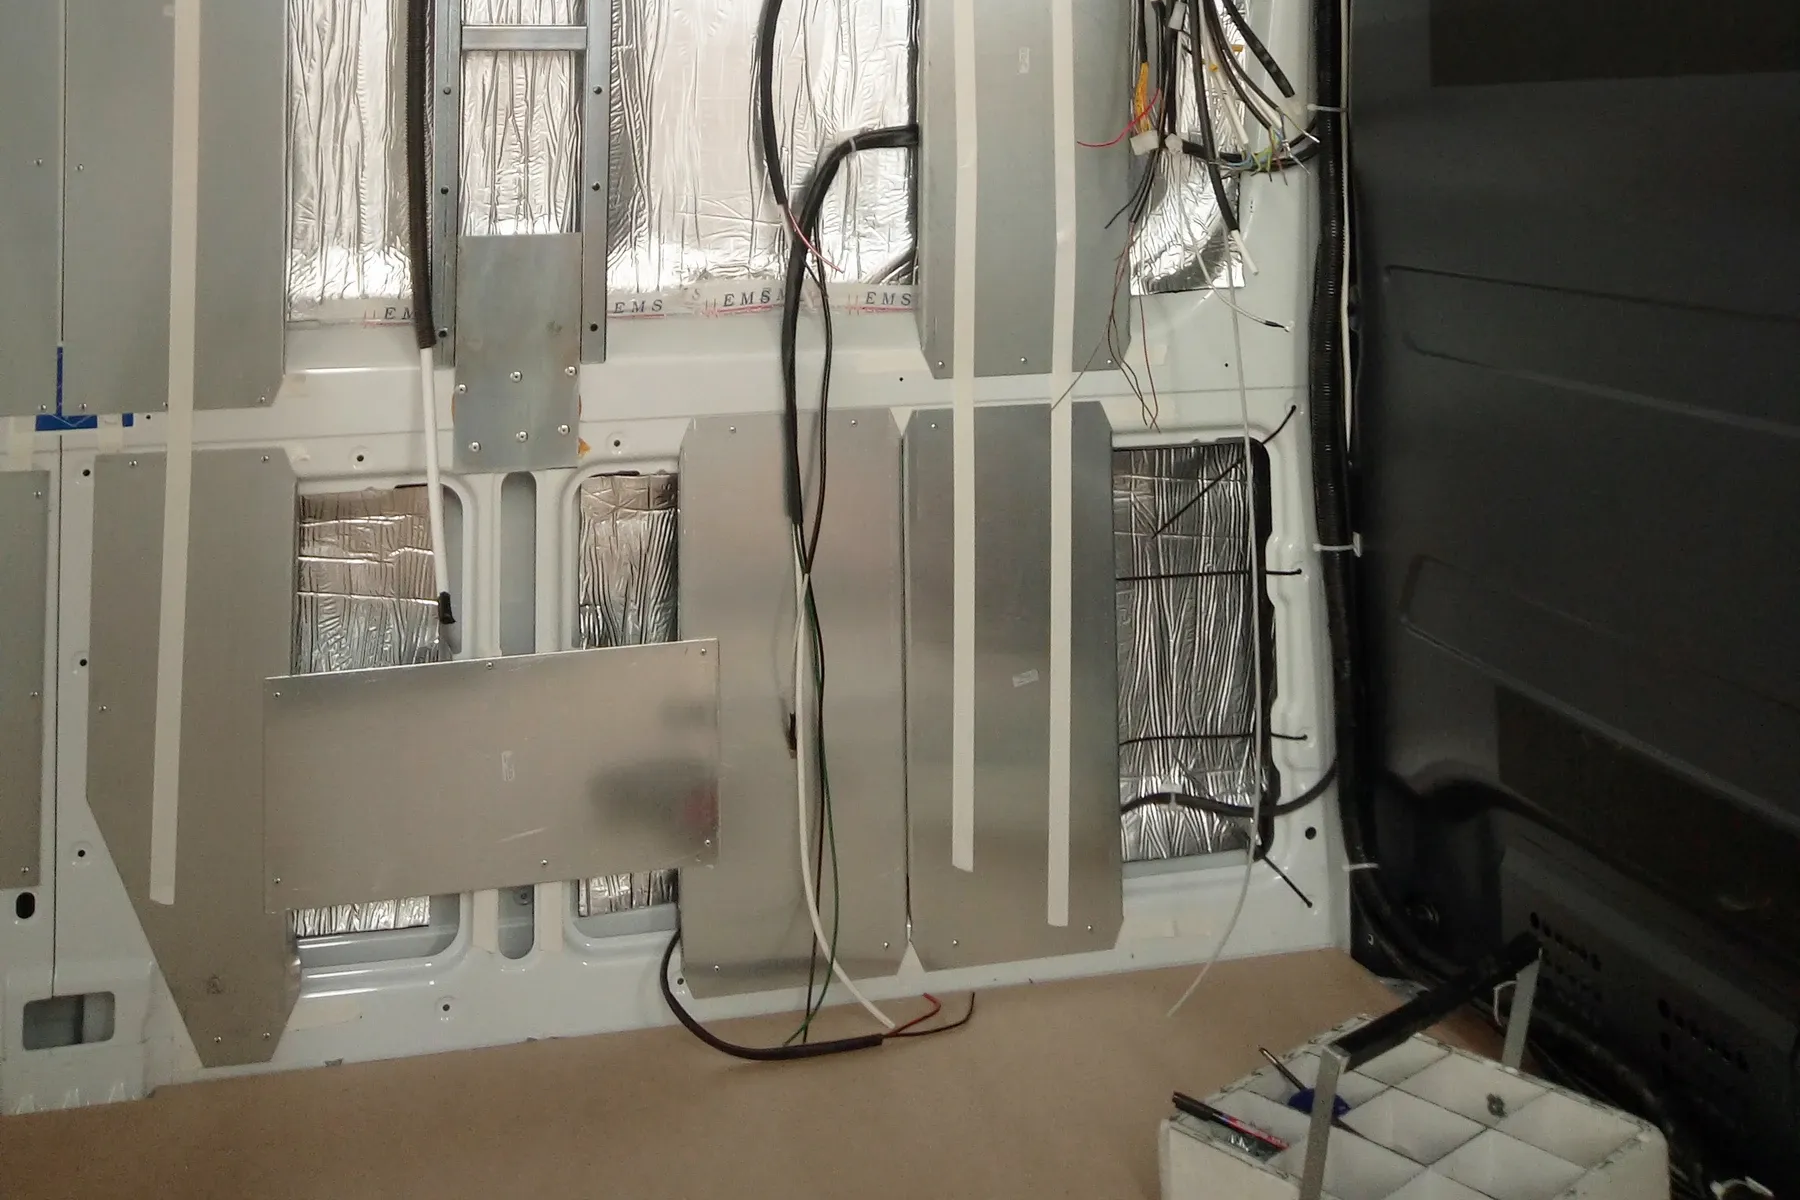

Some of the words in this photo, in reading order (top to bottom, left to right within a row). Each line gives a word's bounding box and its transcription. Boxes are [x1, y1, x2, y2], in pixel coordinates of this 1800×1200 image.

[723, 288, 771, 307] EMS
[866, 291, 912, 306] EMS
[383, 307, 416, 320] EM
[613, 299, 663, 314] EMS
